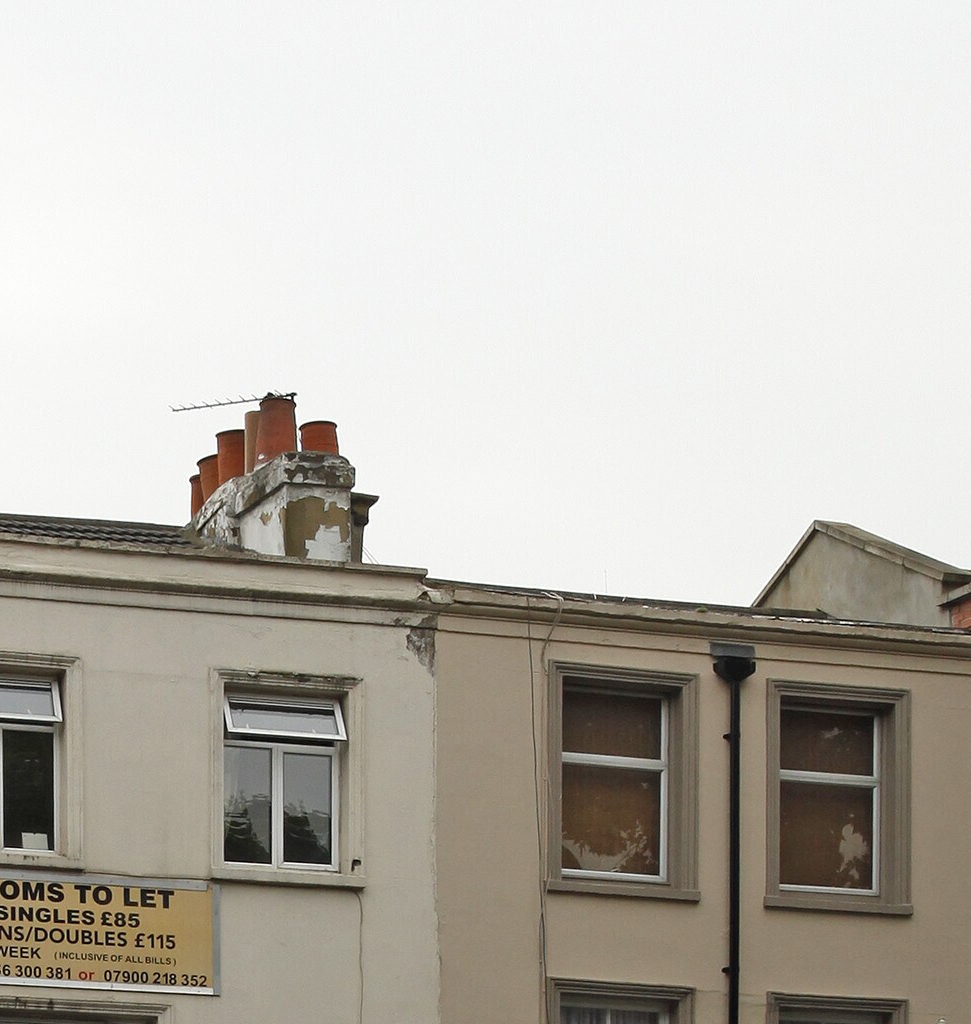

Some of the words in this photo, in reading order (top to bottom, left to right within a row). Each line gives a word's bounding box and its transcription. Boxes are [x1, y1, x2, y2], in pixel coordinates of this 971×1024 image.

[74, 884, 113, 905] TO
[123, 887, 175, 909] LET
[101, 911, 140, 928] £85
[134, 933, 176, 949] £115
[110, 954, 123, 962] OF
[125, 955, 143, 963] ALL
[15, 965, 42, 978] 300
[46, 967, 72, 980] 381
[78, 970, 95, 981] or
[103, 970, 149, 984] 07900
[152, 972, 177, 986] 218
[181, 974, 207, 987] 352
